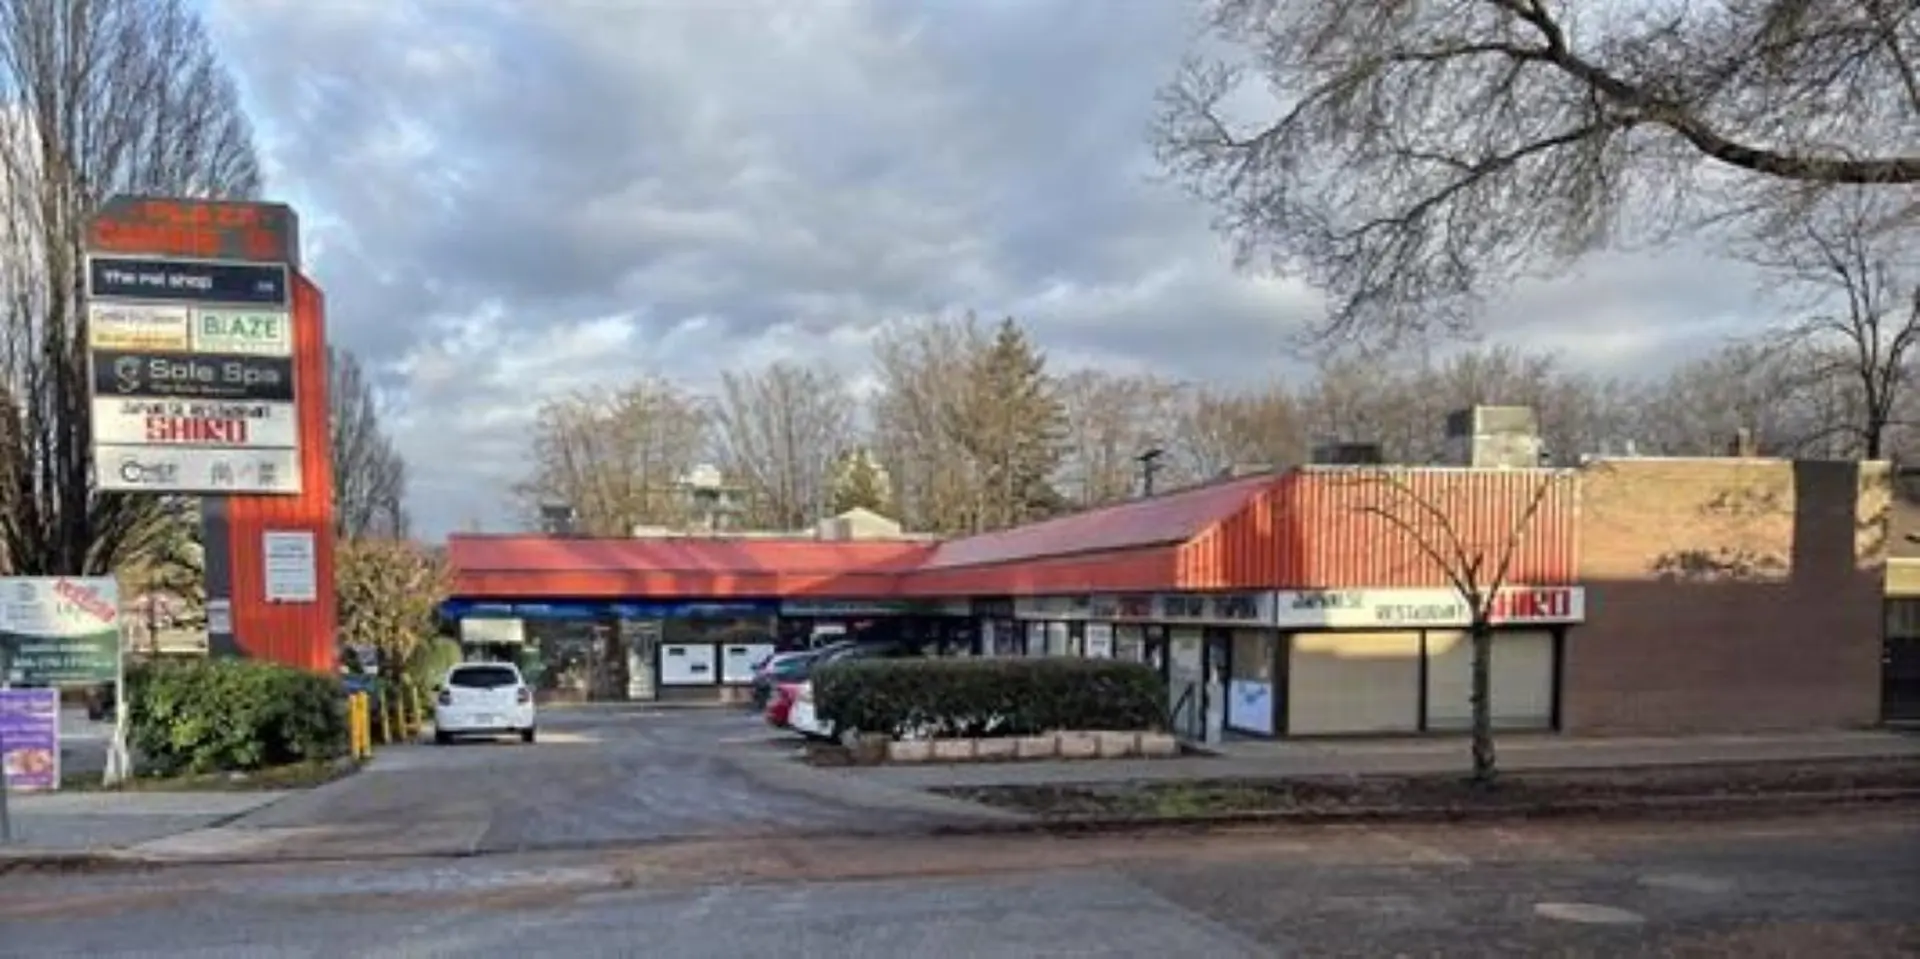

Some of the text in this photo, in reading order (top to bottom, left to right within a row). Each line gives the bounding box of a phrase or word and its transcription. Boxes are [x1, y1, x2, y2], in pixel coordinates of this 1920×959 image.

[149, 358, 281, 385] Sole Spa
[146, 416, 246, 444] SHIRO
